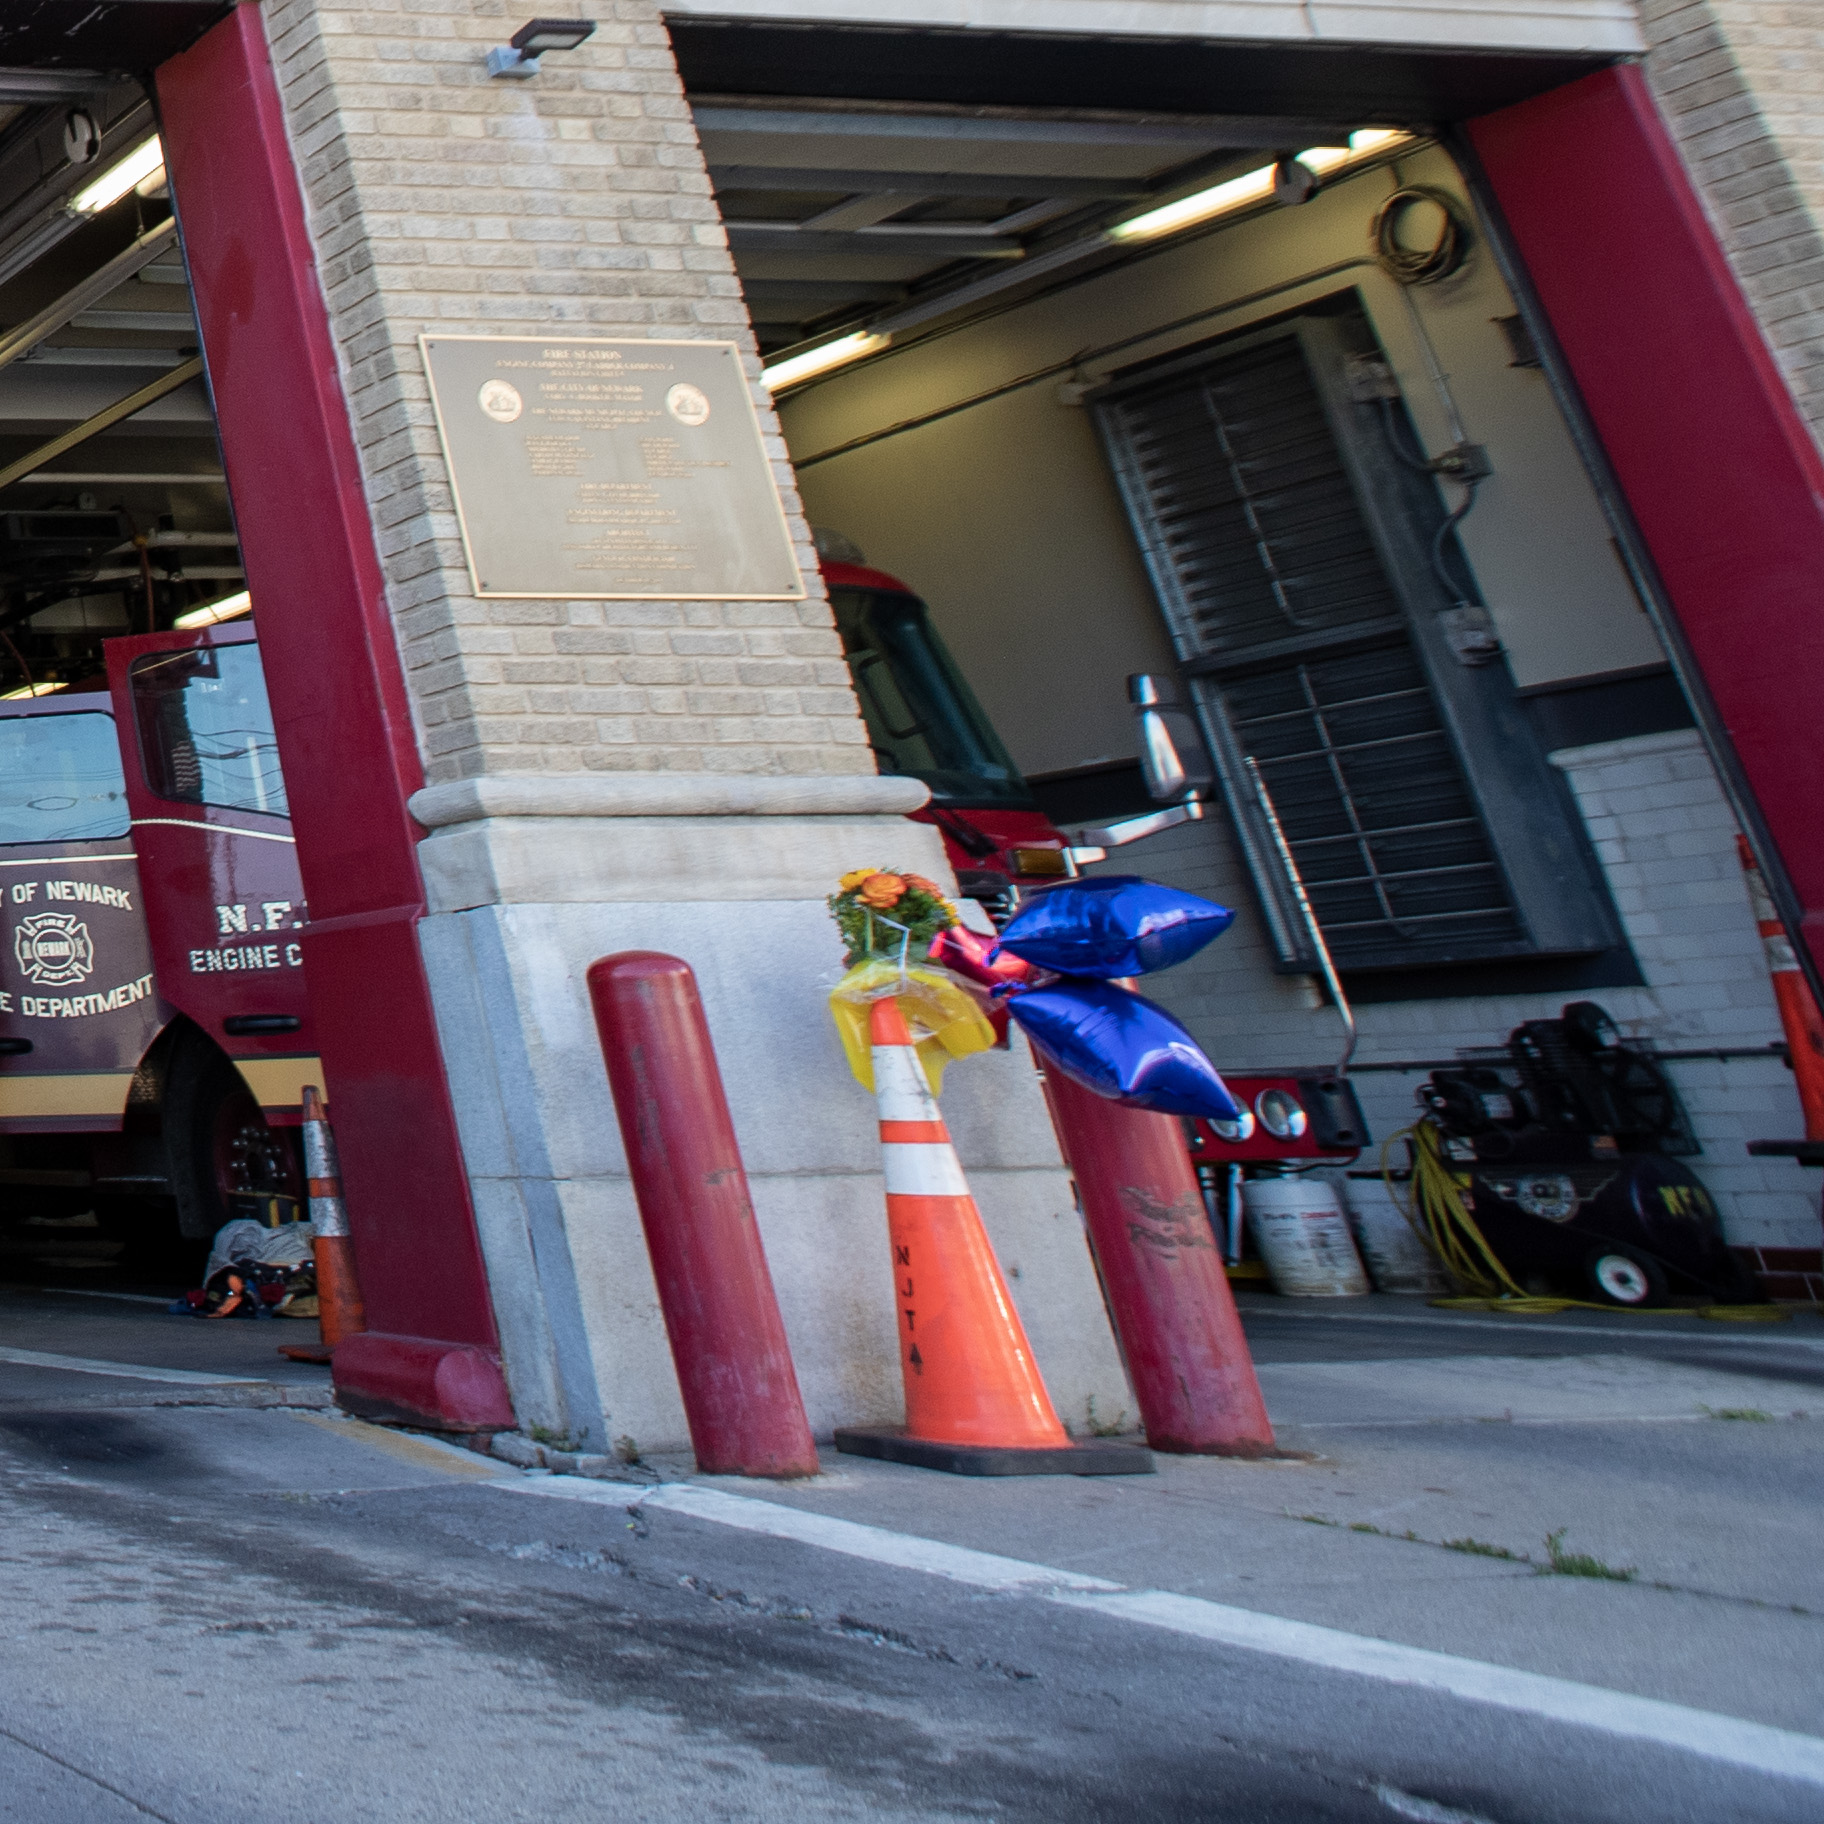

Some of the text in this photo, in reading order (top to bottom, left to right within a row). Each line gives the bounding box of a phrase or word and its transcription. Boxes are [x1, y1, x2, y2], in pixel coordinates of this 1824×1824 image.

[12, 882, 39, 904] OF
[45, 880, 133, 911] NEWARK
[216, 900, 310, 934] N.F.
[189, 944, 281, 972] ENGINE
[21, 972, 153, 1018] DEPARTMENT
